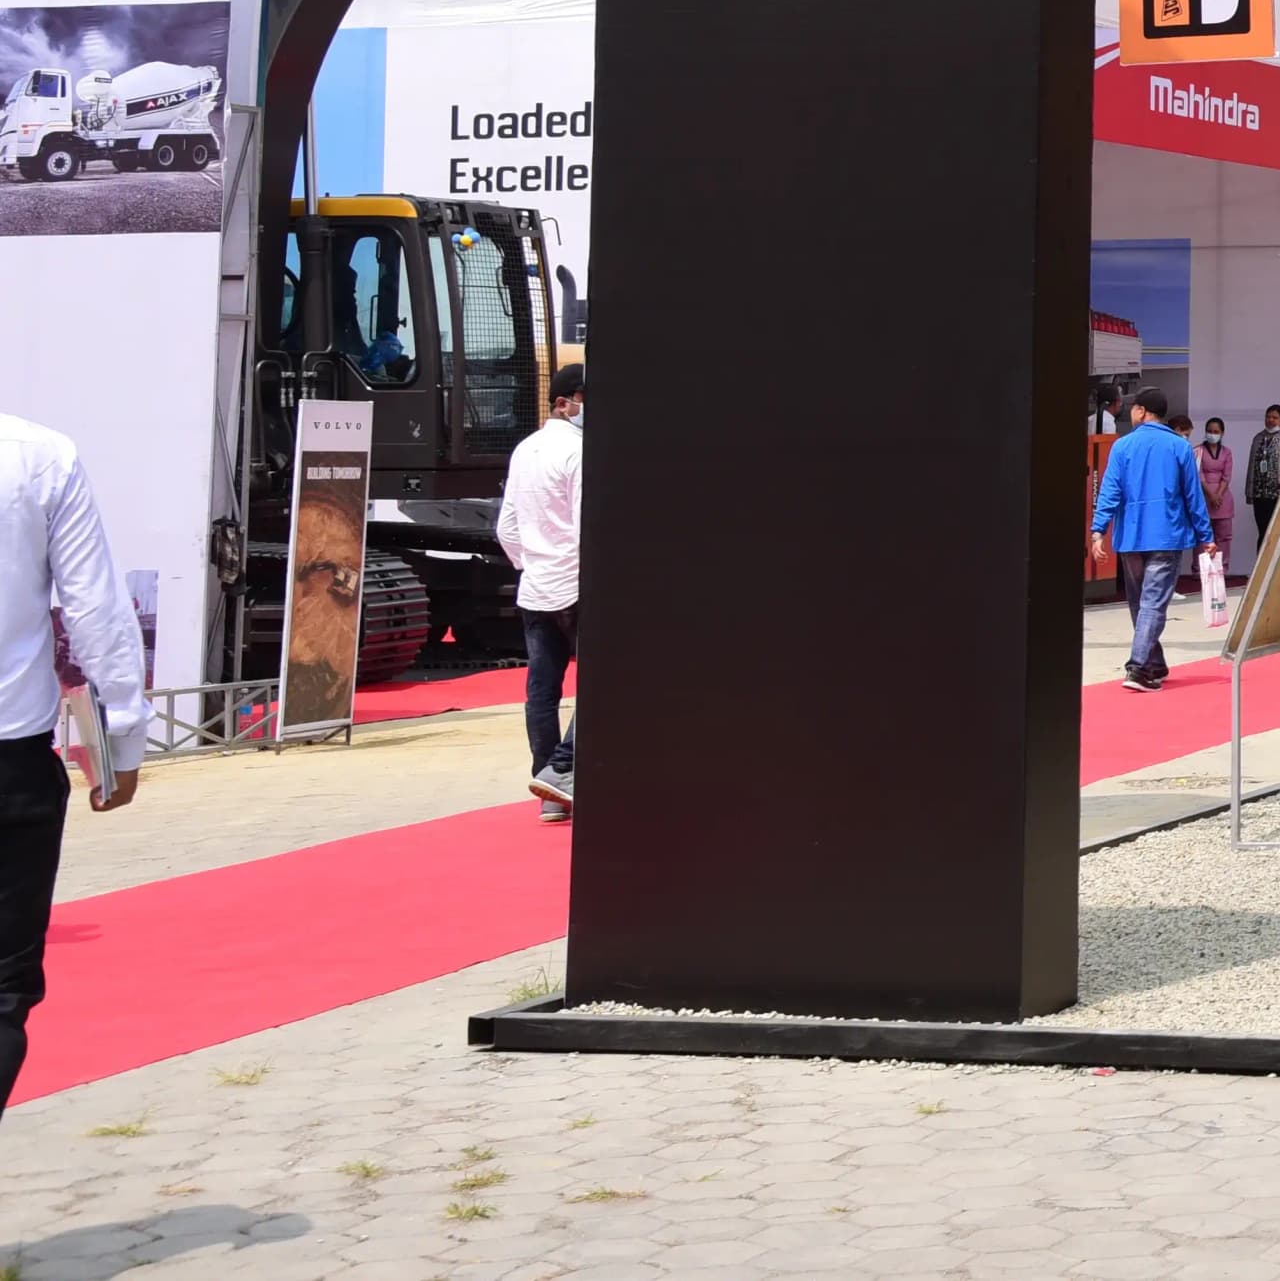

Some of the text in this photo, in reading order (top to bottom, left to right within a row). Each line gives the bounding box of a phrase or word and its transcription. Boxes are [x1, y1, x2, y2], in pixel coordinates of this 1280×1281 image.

[157, 92, 188, 107] AJAX
[1150, 75, 1260, 130] Mahindra
[451, 101, 592, 140] Loaded
[450, 155, 589, 193] Excelle
[313, 421, 362, 431] VOLVO
